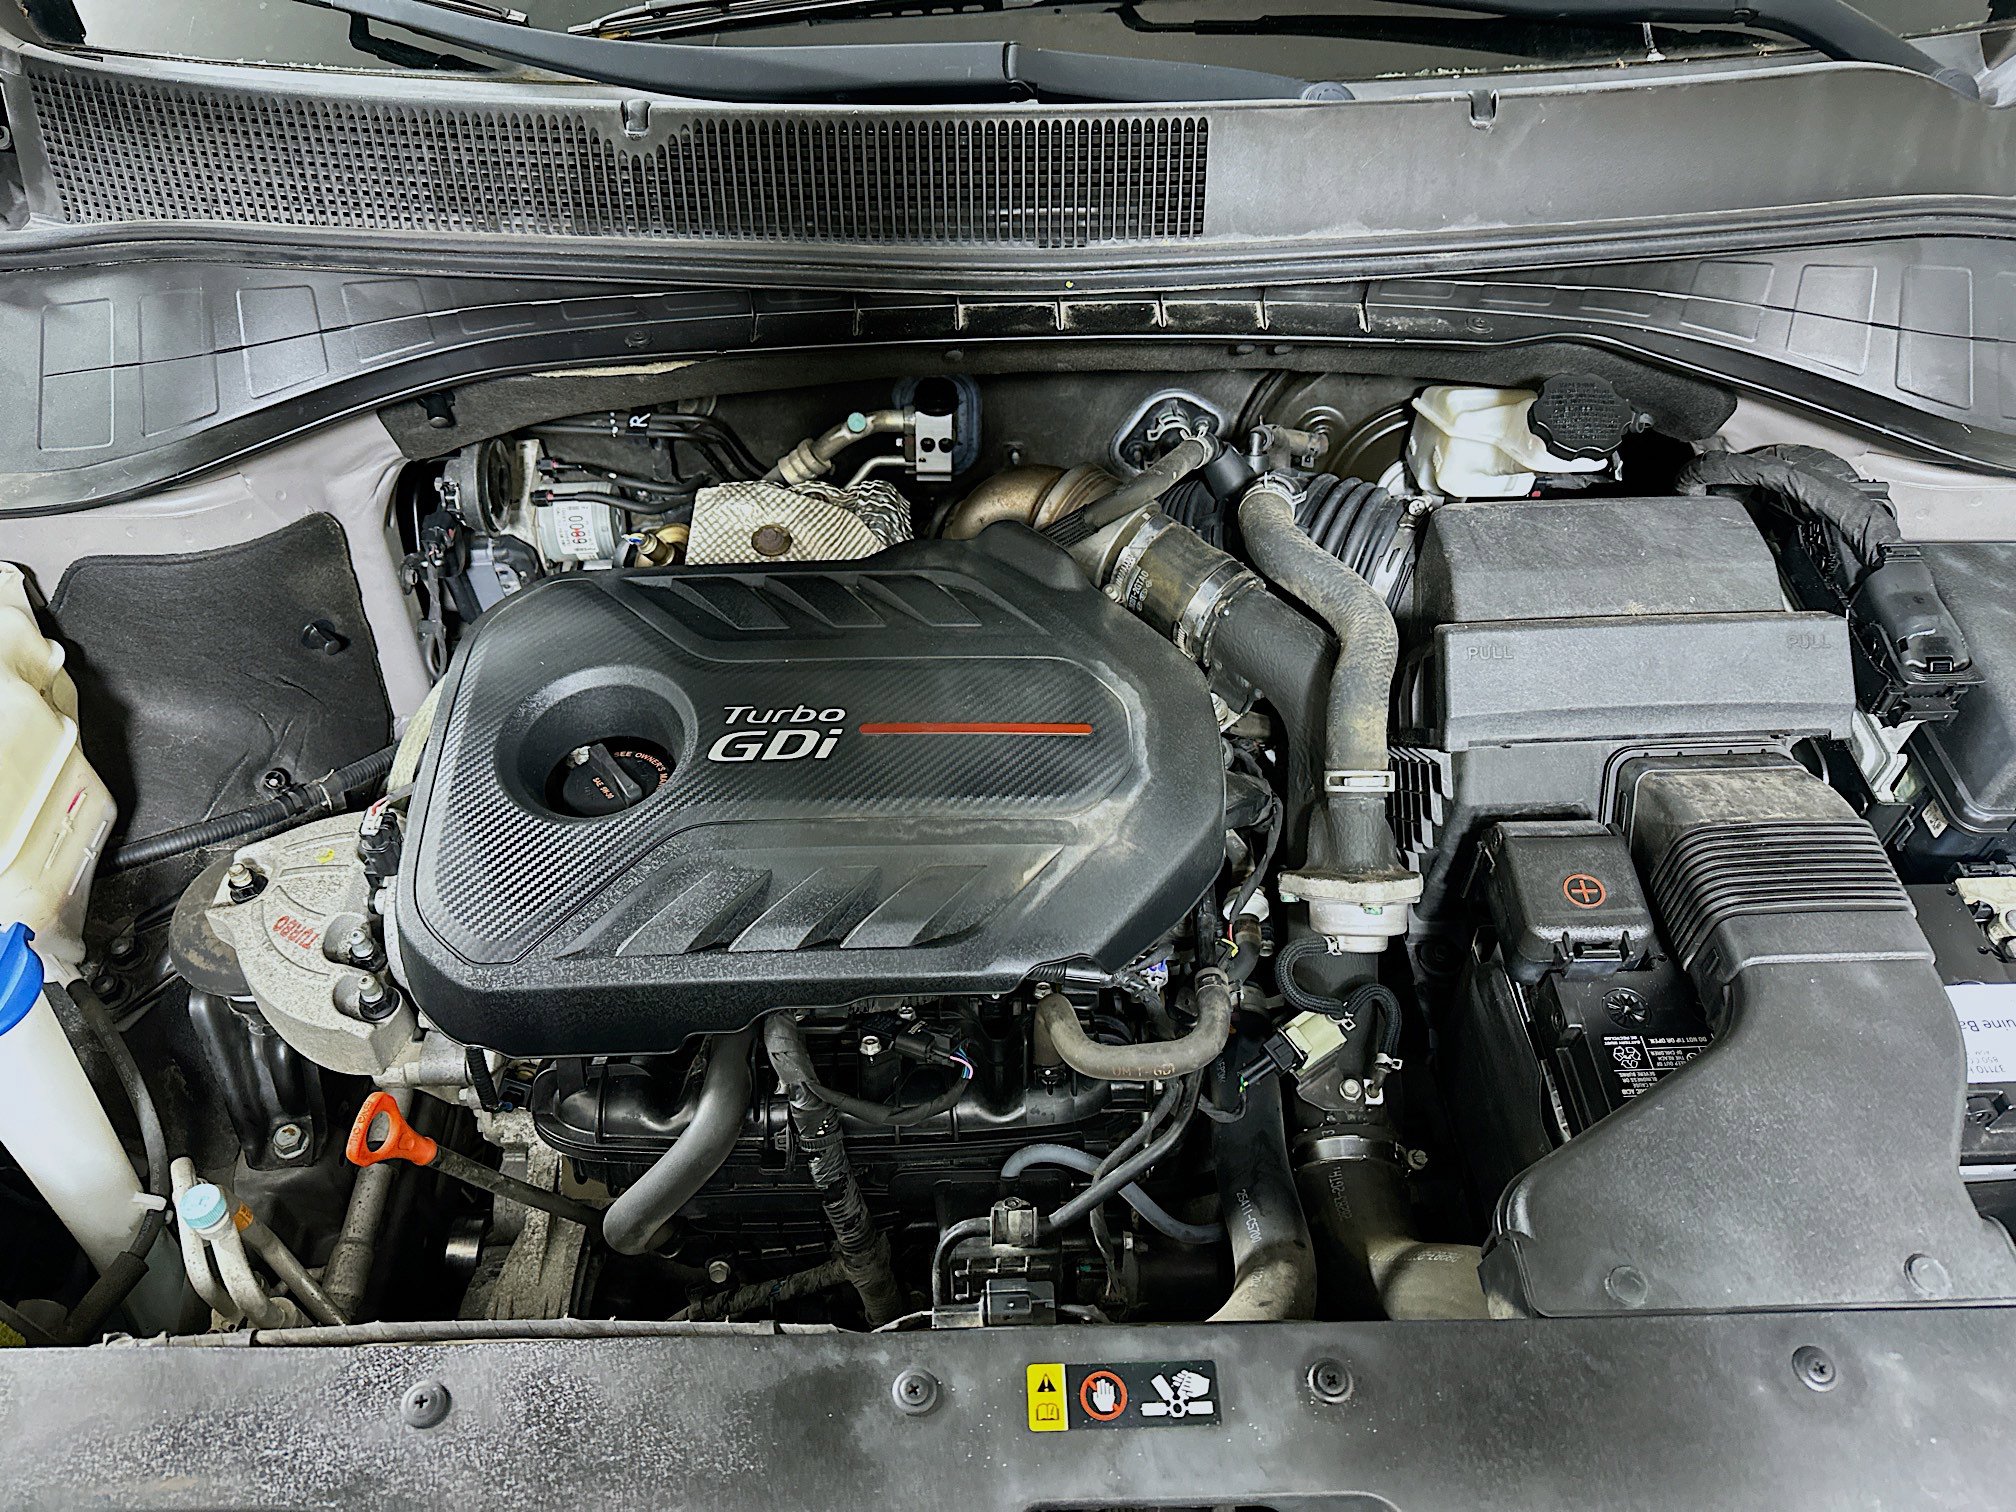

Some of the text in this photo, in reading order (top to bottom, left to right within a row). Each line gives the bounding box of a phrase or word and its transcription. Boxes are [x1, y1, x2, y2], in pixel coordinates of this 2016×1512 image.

[629, 413, 651, 428] R
[1786, 634, 1831, 650] PULL
[1465, 646, 1514, 660] PULL
[724, 705, 846, 725] Turbo
[634, 752, 667, 772] OWNER'S
[272, 916, 321, 950] TURBO
[1235, 1188, 1262, 1243] 25411-C5700
